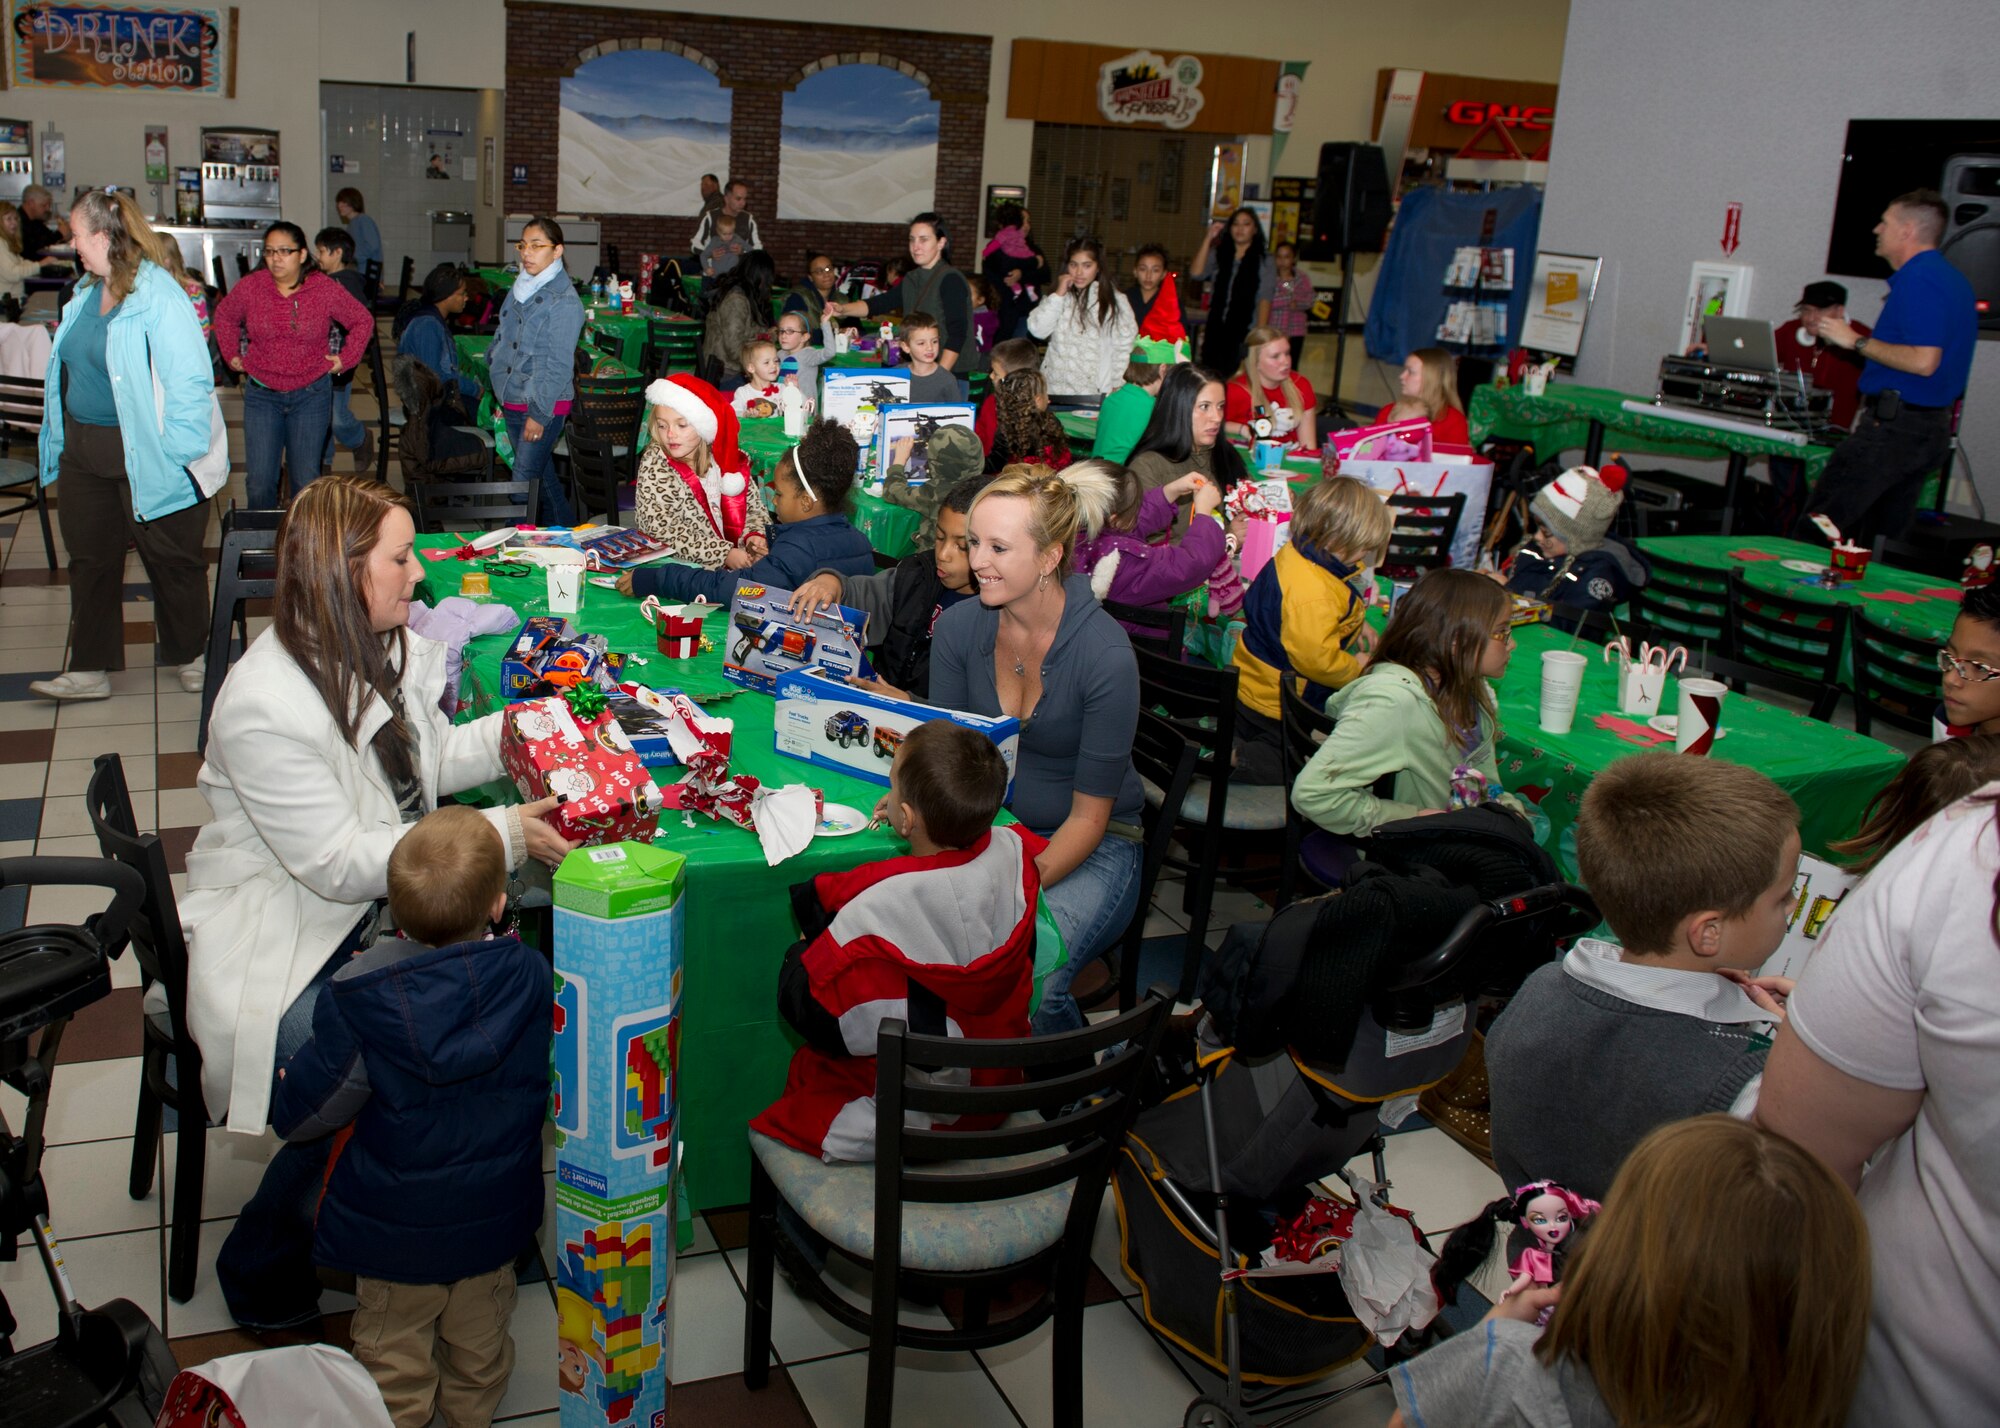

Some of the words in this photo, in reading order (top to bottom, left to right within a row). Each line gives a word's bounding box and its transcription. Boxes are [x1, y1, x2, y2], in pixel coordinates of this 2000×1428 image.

[34, 11, 200, 63] DRINK
[112, 55, 194, 83] Station
[1448, 100, 1553, 131] GNC
[737, 586, 766, 596] NERF
[650, 751, 674, 759] Military
[528, 762, 538, 780] HO
[597, 762, 606, 771] HO
[625, 761, 634, 772] HO
[610, 770, 630, 787] HO
[605, 784, 614, 796] HO
[578, 802, 586, 812] HO
[589, 796, 610, 814] HO
[572, 1172, 606, 1192] Walmart
[644, 1200, 659, 1209] Lots
[607, 1206, 634, 1220] Blocks!
